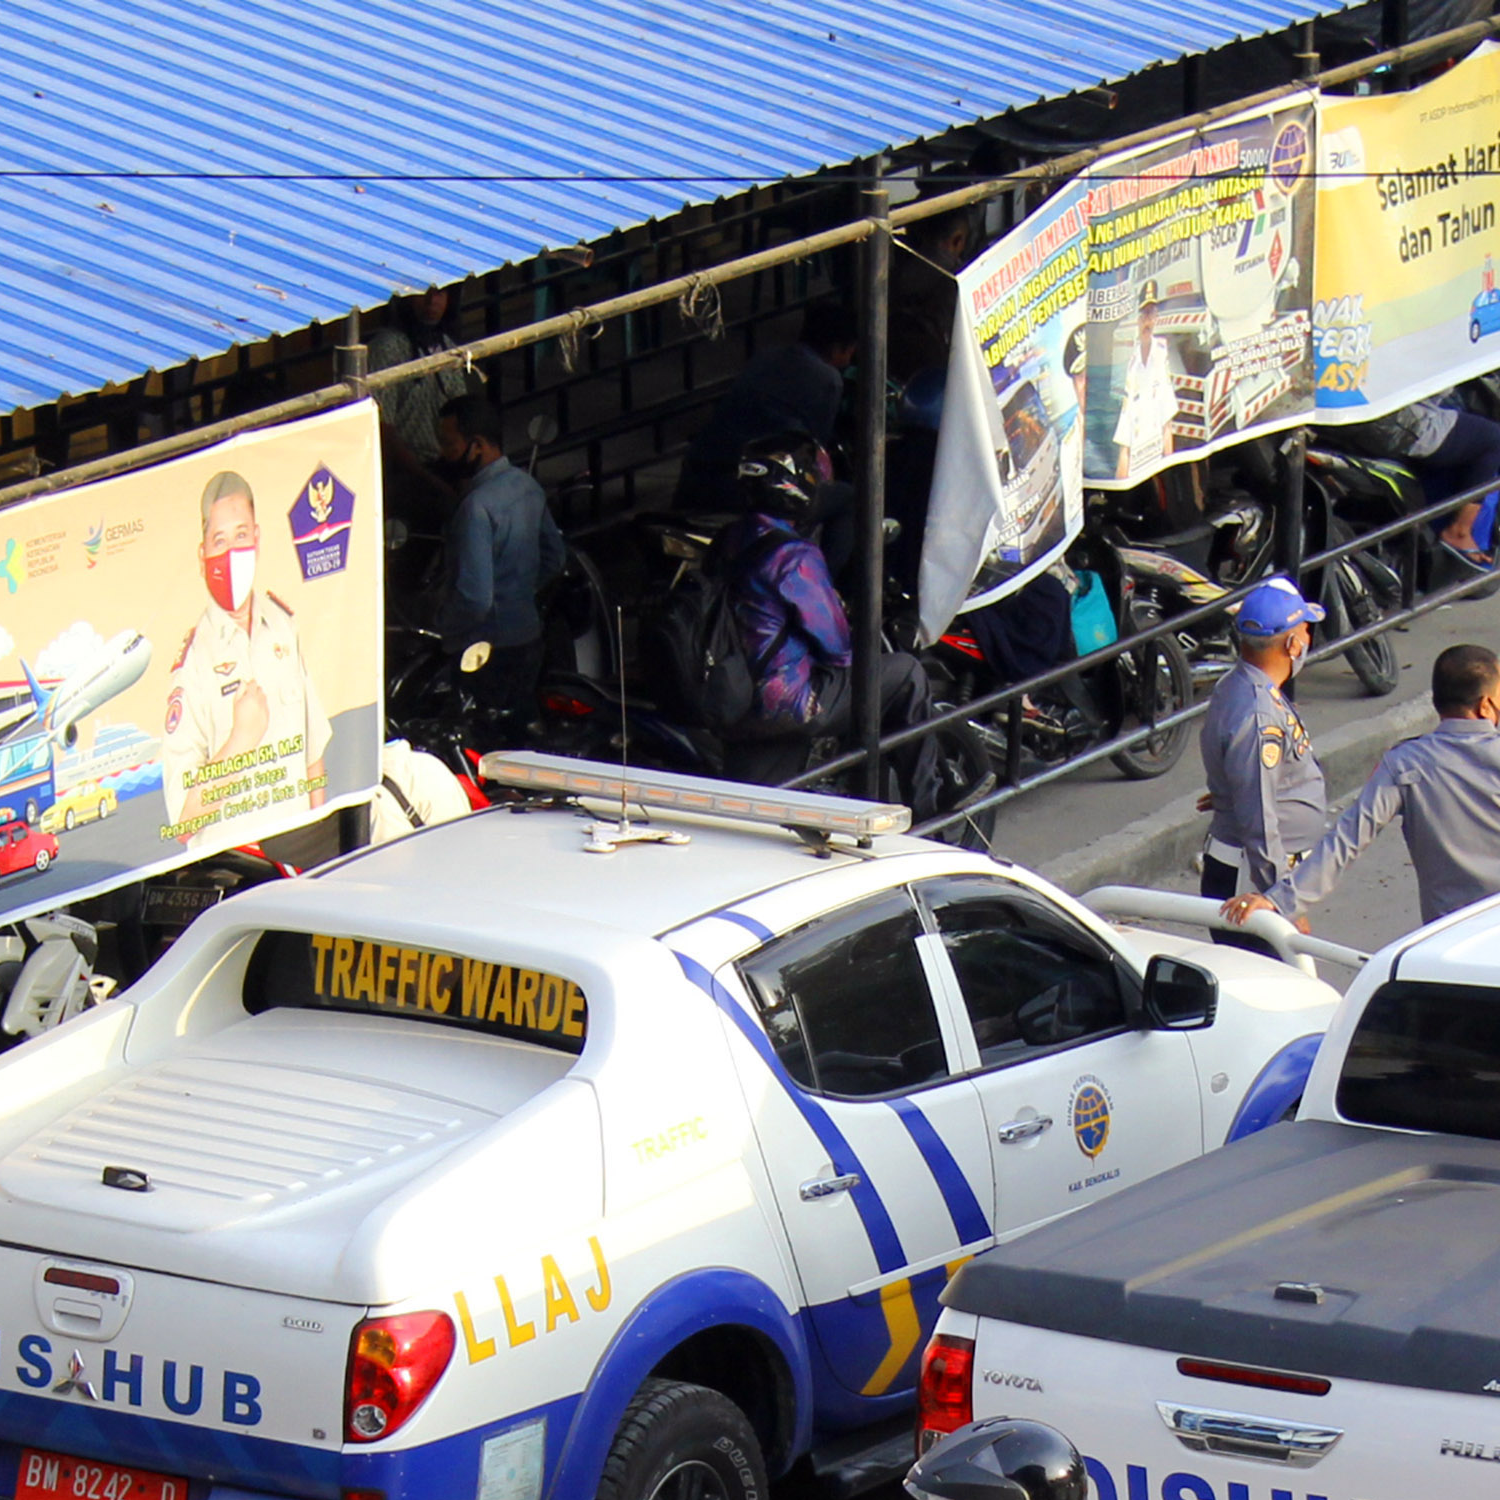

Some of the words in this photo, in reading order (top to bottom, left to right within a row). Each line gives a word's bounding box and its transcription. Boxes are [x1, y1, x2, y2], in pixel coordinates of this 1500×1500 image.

[1376, 154, 1458, 211] Selamat
[1215, 201, 1256, 228] KAPAL
[1400, 226, 1432, 263] dan
[1437, 199, 1495, 248] Tahun
[1017, 245, 1081, 309] ANGKUTAN
[1115, 211, 1137, 238] DAN
[105, 518, 145, 542] GERMAS
[183, 771, 195, 789] H.
[197, 750, 257, 785] AFRILAGAN
[259, 744, 277, 765] SH,
[201, 775, 252, 807] Sekretaris
[253, 766, 288, 788] Satgas
[159, 809, 222, 842] Penanganan
[272, 783, 296, 803] Kota
[297, 769, 328, 794] Dumai
[311, 933, 454, 1014] TRAFFIC
[630, 1114, 709, 1166] TRAFFIC
[452, 1236, 613, 1367] LLAJ
[981, 1368, 1045, 1394] TOYOTA
[25, 1454, 60, 1492] BM
